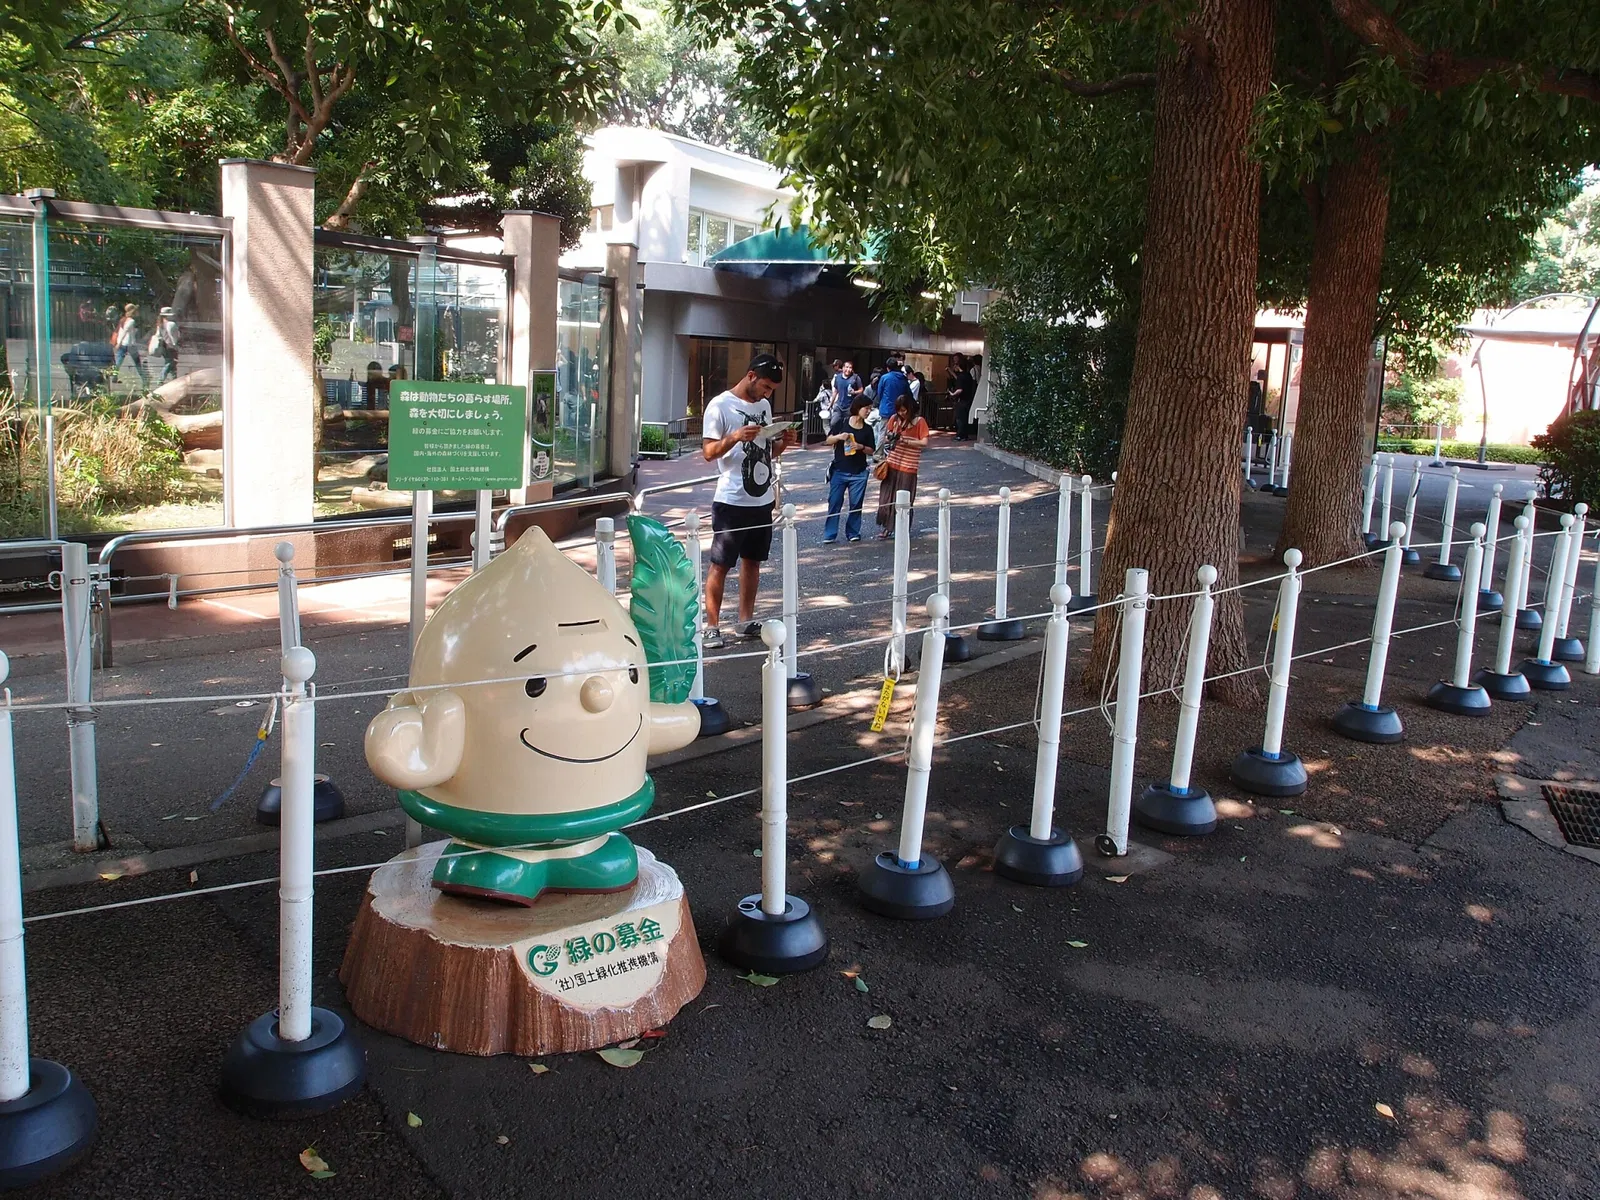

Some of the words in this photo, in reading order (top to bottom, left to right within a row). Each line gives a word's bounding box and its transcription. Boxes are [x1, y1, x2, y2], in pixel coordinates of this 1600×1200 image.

[400, 391, 512, 406] 森は動物たちの暮らす場所。
[409, 408, 504, 420] 森を大切にしましょう。
[874, 684, 891, 729] またがないでね
[563, 916, 665, 966] 緑の募金
